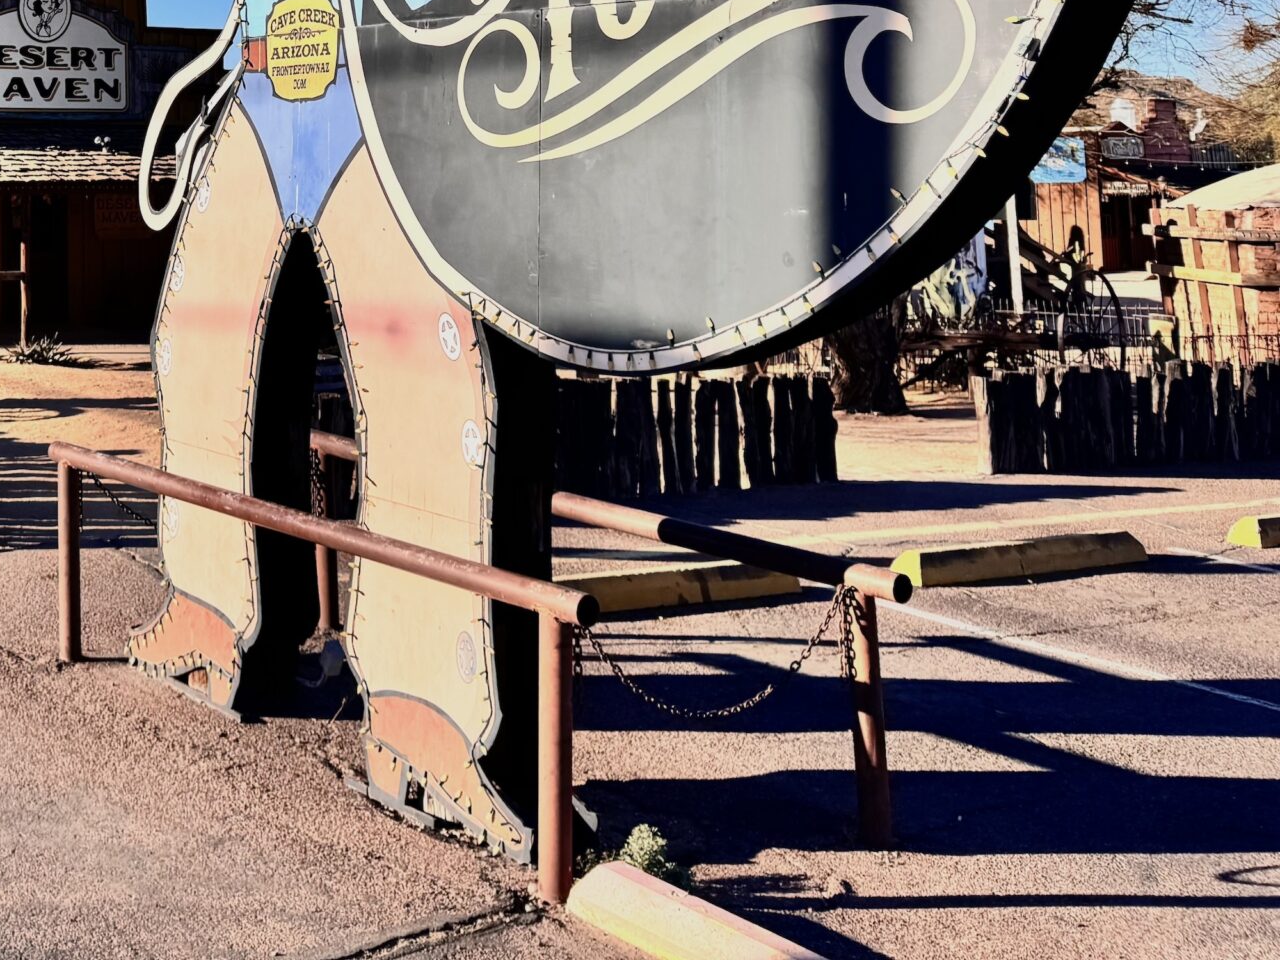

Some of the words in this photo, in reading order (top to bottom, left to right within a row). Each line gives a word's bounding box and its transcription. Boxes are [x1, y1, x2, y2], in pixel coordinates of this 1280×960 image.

[270, 10, 296, 33] CAVE
[298, 8, 336, 28] CREEK
[270, 42, 331, 60] ARIZONA
